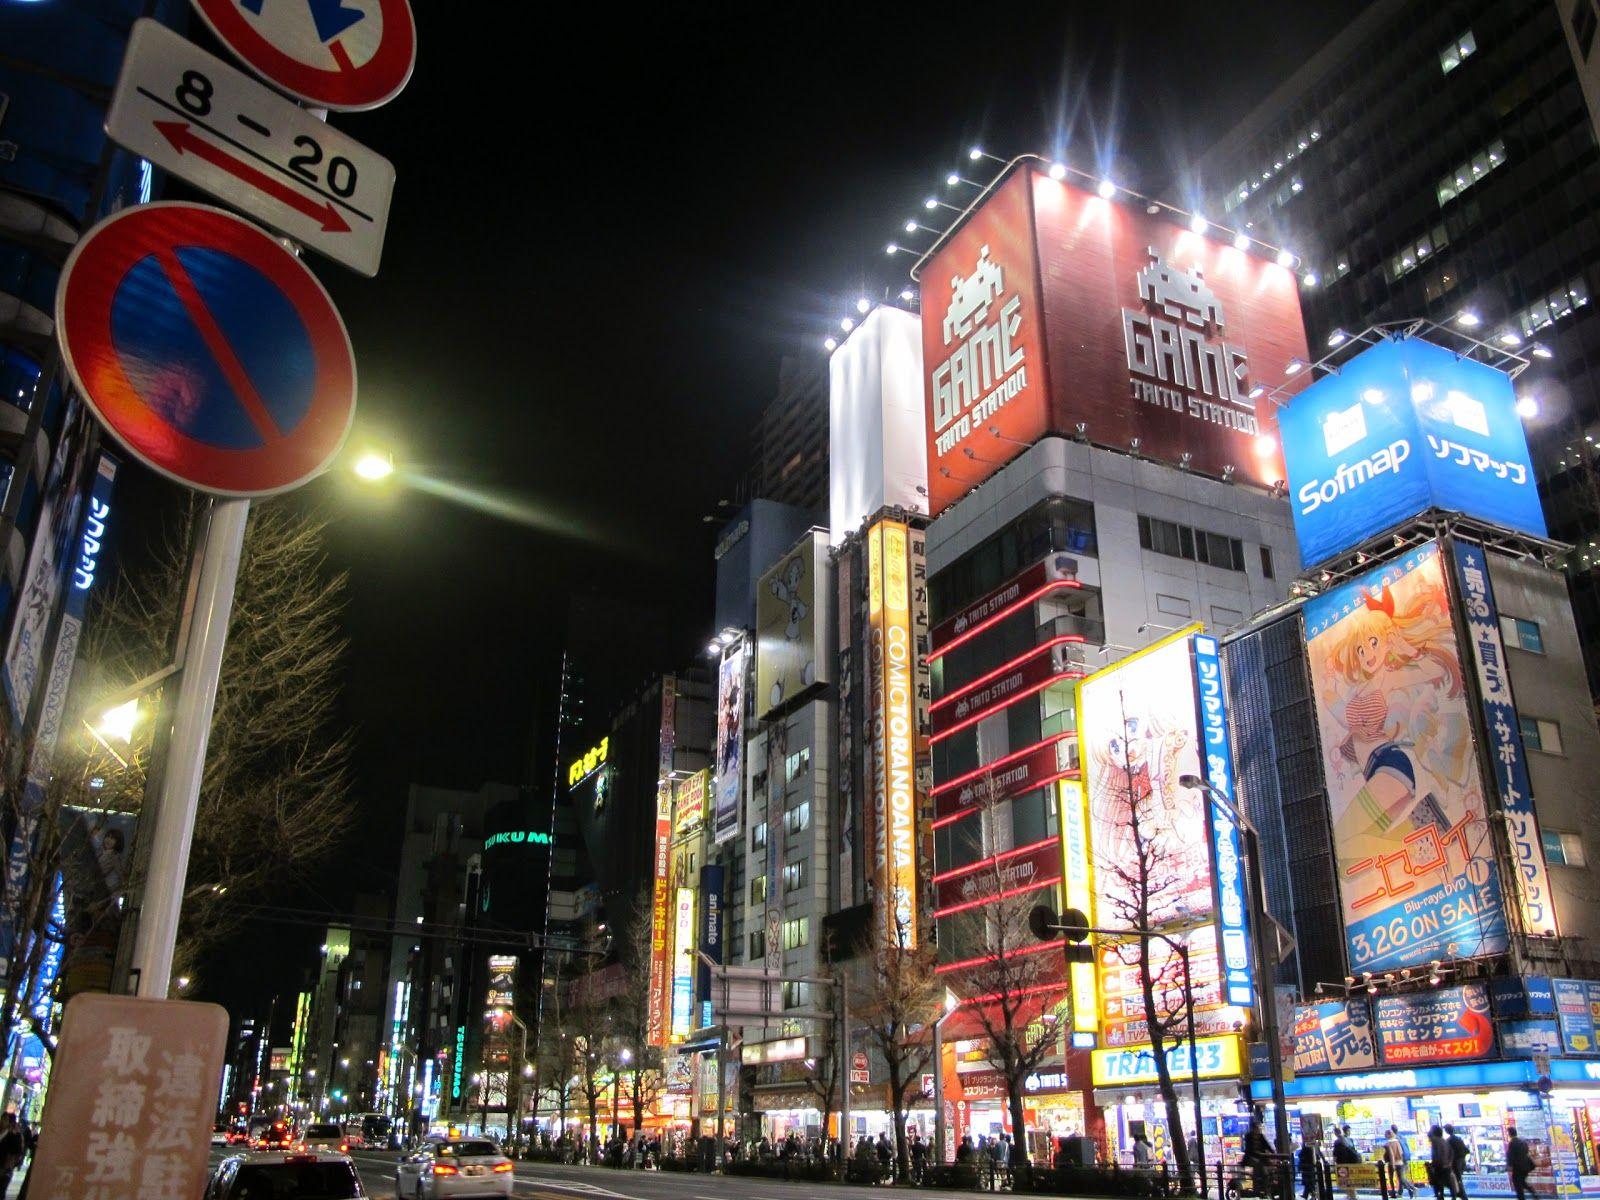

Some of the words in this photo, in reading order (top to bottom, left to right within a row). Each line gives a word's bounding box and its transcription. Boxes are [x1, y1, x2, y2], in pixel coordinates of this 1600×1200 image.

[933, 295, 1025, 432] GAME
[1122, 307, 1255, 409] GAME
[935, 416, 971, 457] TAITO
[973, 366, 1027, 429] STATION
[1130, 378, 1183, 413] TAITO
[1189, 396, 1259, 437] STATION
[1299, 439, 1410, 515] Sofmap
[1427, 435, 1527, 484] ソフマップ
[968, 604, 988, 623] TAITO
[989, 584, 1019, 612] STATION
[970, 691, 990, 711] TAITO
[992, 673, 1023, 699] STATION
[1200, 661, 1225, 744] ソフマップ
[1495, 720, 1522, 807] サポート
[1346, 809, 1476, 909] ニセコイ
[1513, 820, 1543, 923] ソフマップ
[708, 893, 719, 946] animate
[1352, 917, 1408, 963] 3.26
[1411, 909, 1440, 938] ON
[1441, 886, 1497, 926] SALE
[1412, 1011, 1459, 1026] ソフマップ
[452, 1026, 465, 1099] TSUKUMO
[83, 1027, 152, 1200] 取締強
